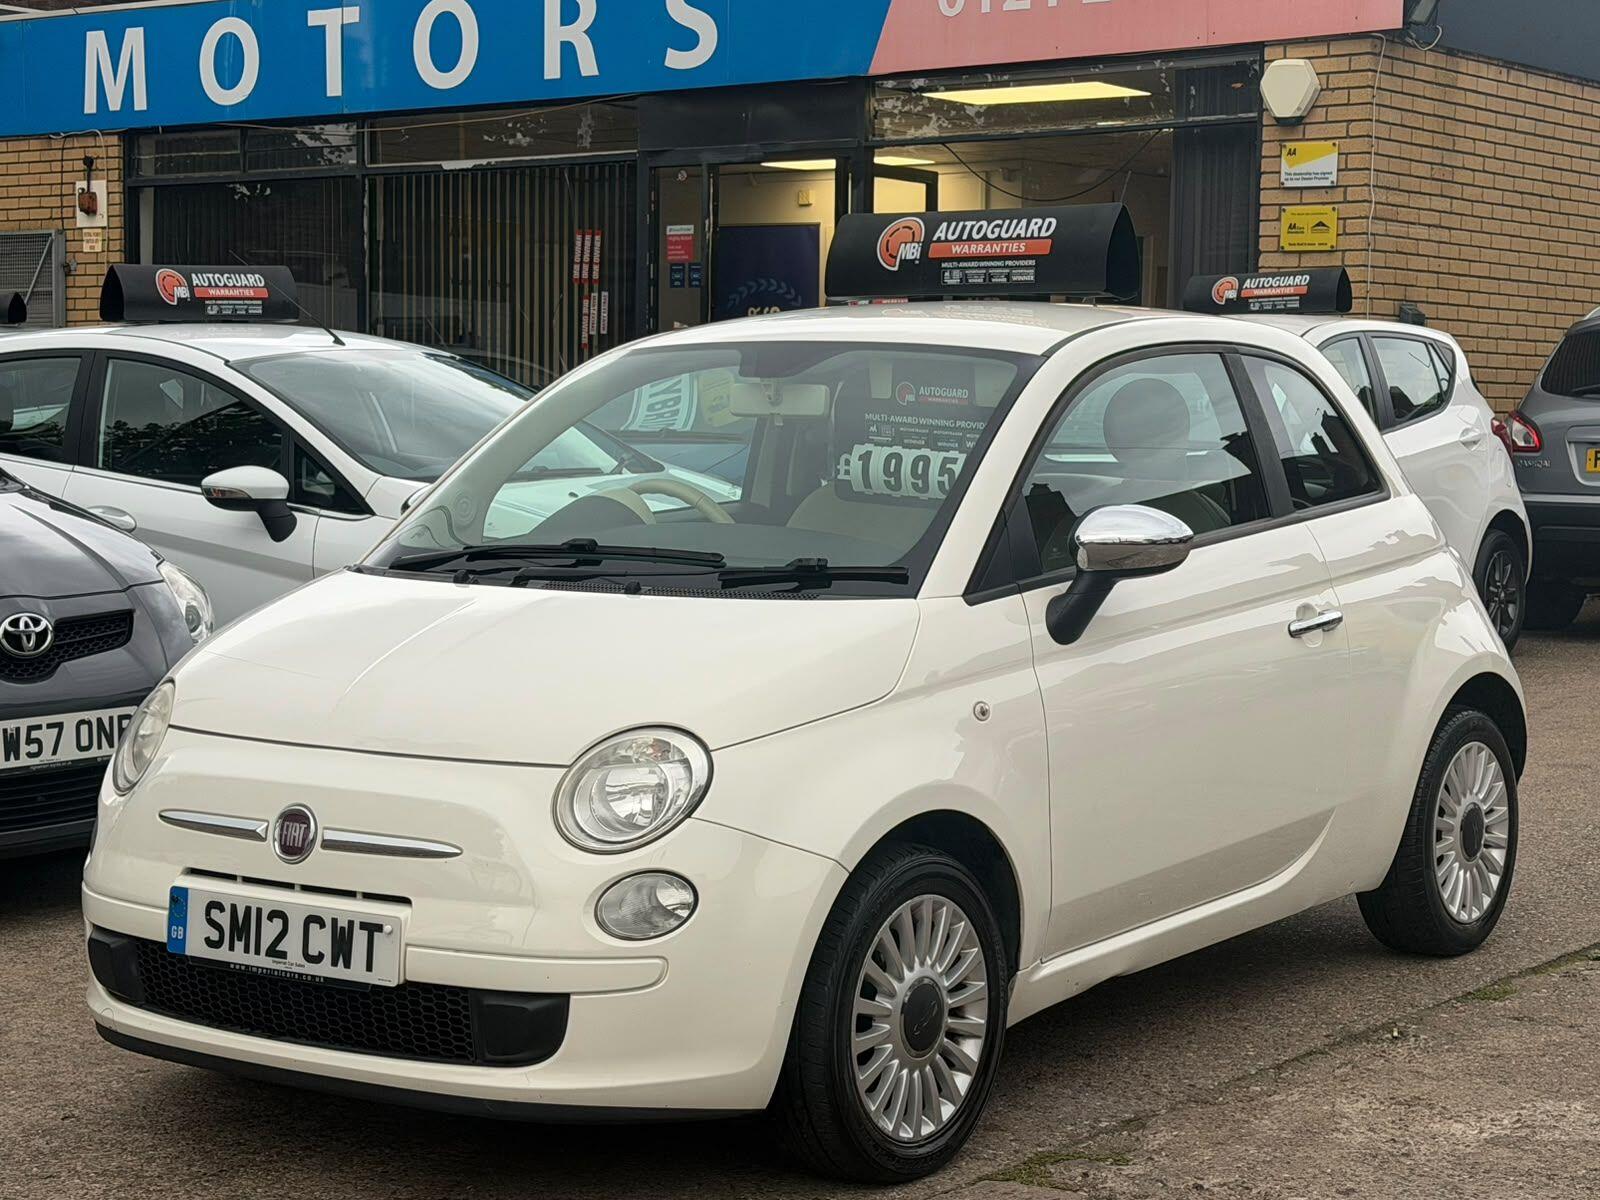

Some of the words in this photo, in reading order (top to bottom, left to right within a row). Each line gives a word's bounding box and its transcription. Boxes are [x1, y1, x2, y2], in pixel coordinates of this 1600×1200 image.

[84, 0, 718, 114] MOTORS
[1286, 148, 1297, 157] AA
[932, 217, 1057, 241] AUTOGUARD
[951, 243, 1026, 255] WARRANTIES
[191, 273, 265, 287] AUTOGUARD
[1242, 275, 1310, 289] AUTOGUARD
[1253, 287, 1294, 295] WARRANTIES
[919, 386, 968, 399] AUTOGUARD
[865, 413, 918, 425] MULTI-AWARD
[919, 417, 955, 428] WINNING
[2, 721, 64, 762] W57
[281, 821, 308, 847] FIAT
[171, 925, 184, 940] GB
[203, 900, 289, 960] SM12
[302, 914, 383, 973] CWT
